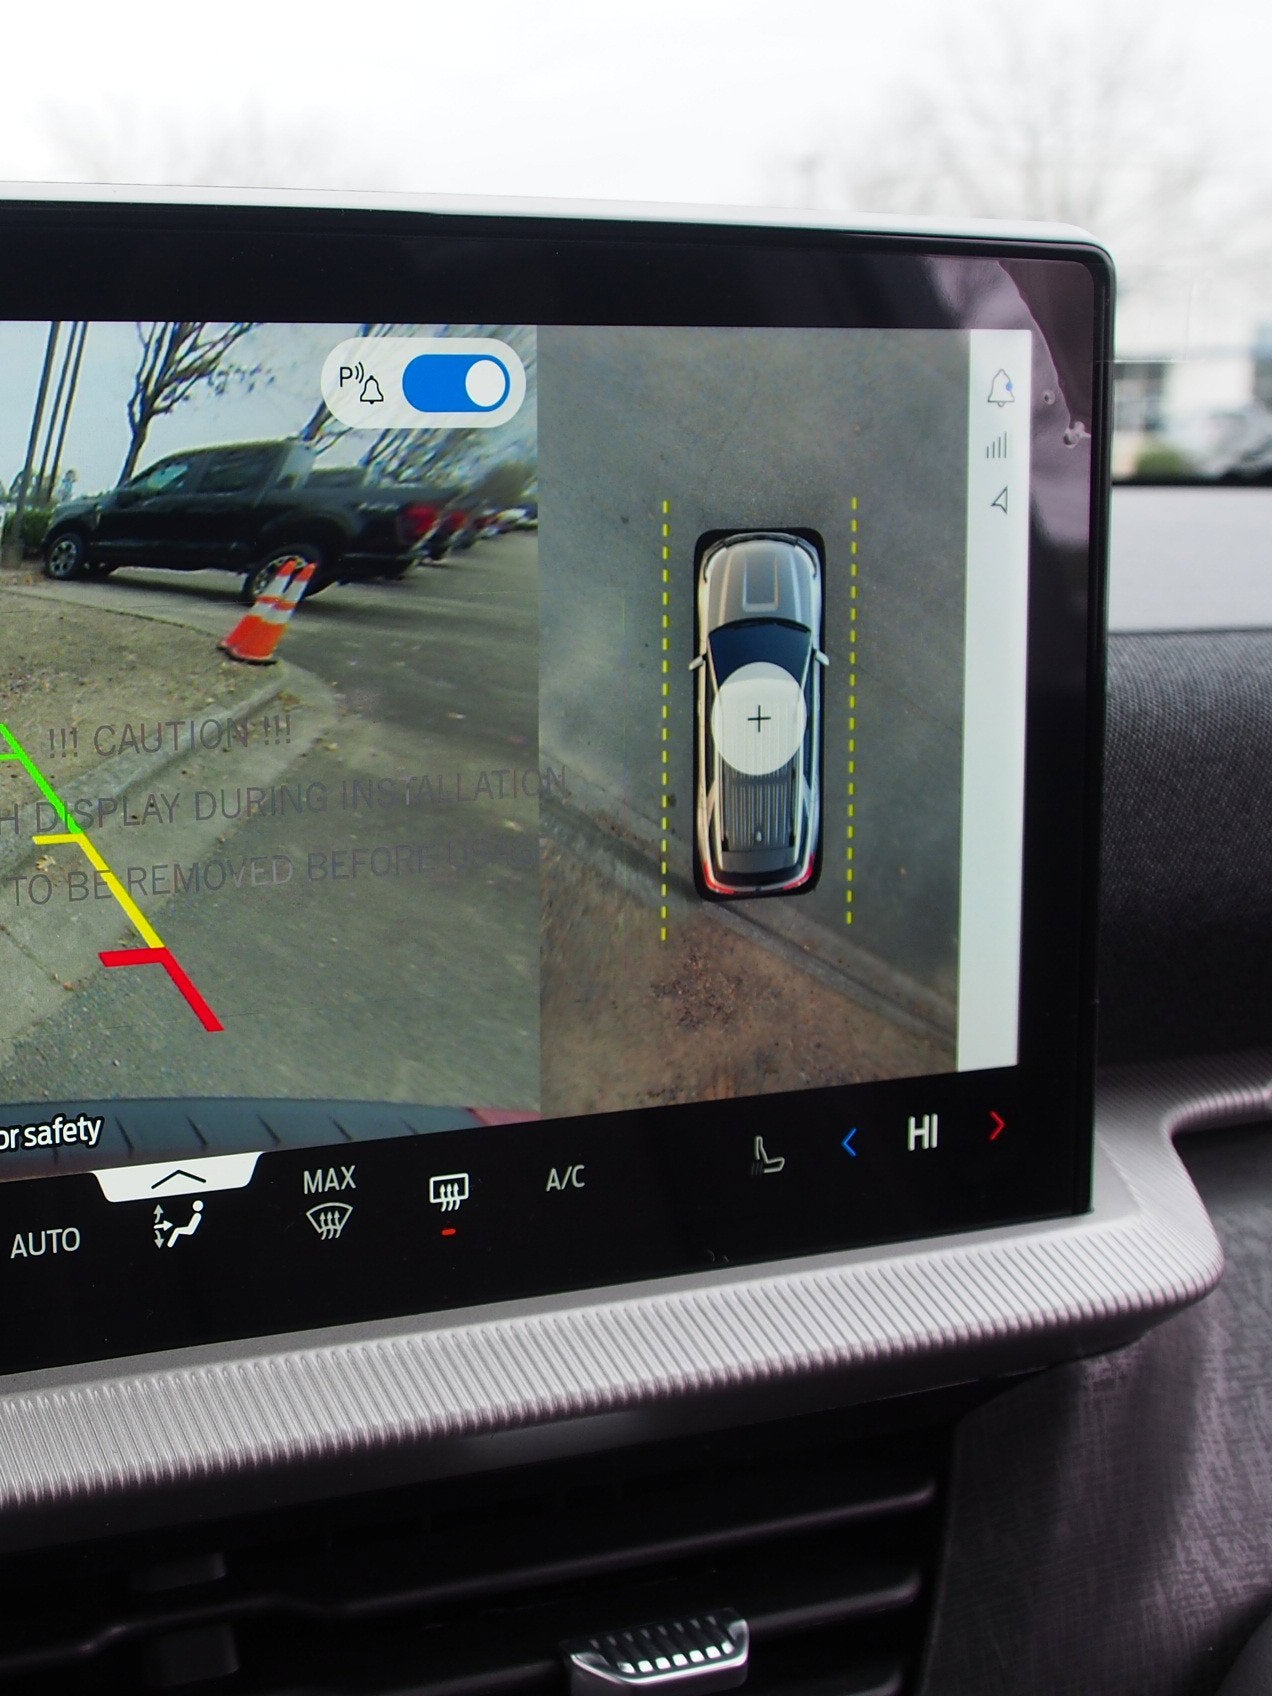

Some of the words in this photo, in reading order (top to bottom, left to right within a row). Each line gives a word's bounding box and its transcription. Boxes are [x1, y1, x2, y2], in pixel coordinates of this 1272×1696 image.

[93, 716, 249, 757] CAUTION
[35, 791, 181, 834] DISPLAY
[195, 781, 328, 821] DURING
[342, 764, 570, 812] INSTALLATION
[6, 873, 53, 905] TO
[68, 869, 112, 900] BE
[128, 853, 295, 897] REMOVED
[307, 842, 436, 882] BEFORE
[23, 1115, 103, 1148] safety
[908, 1113, 939, 1151] HI
[303, 1165, 357, 1195] MAX
[546, 1164, 586, 1192] A/C
[10, 1227, 82, 1260] AUTO
